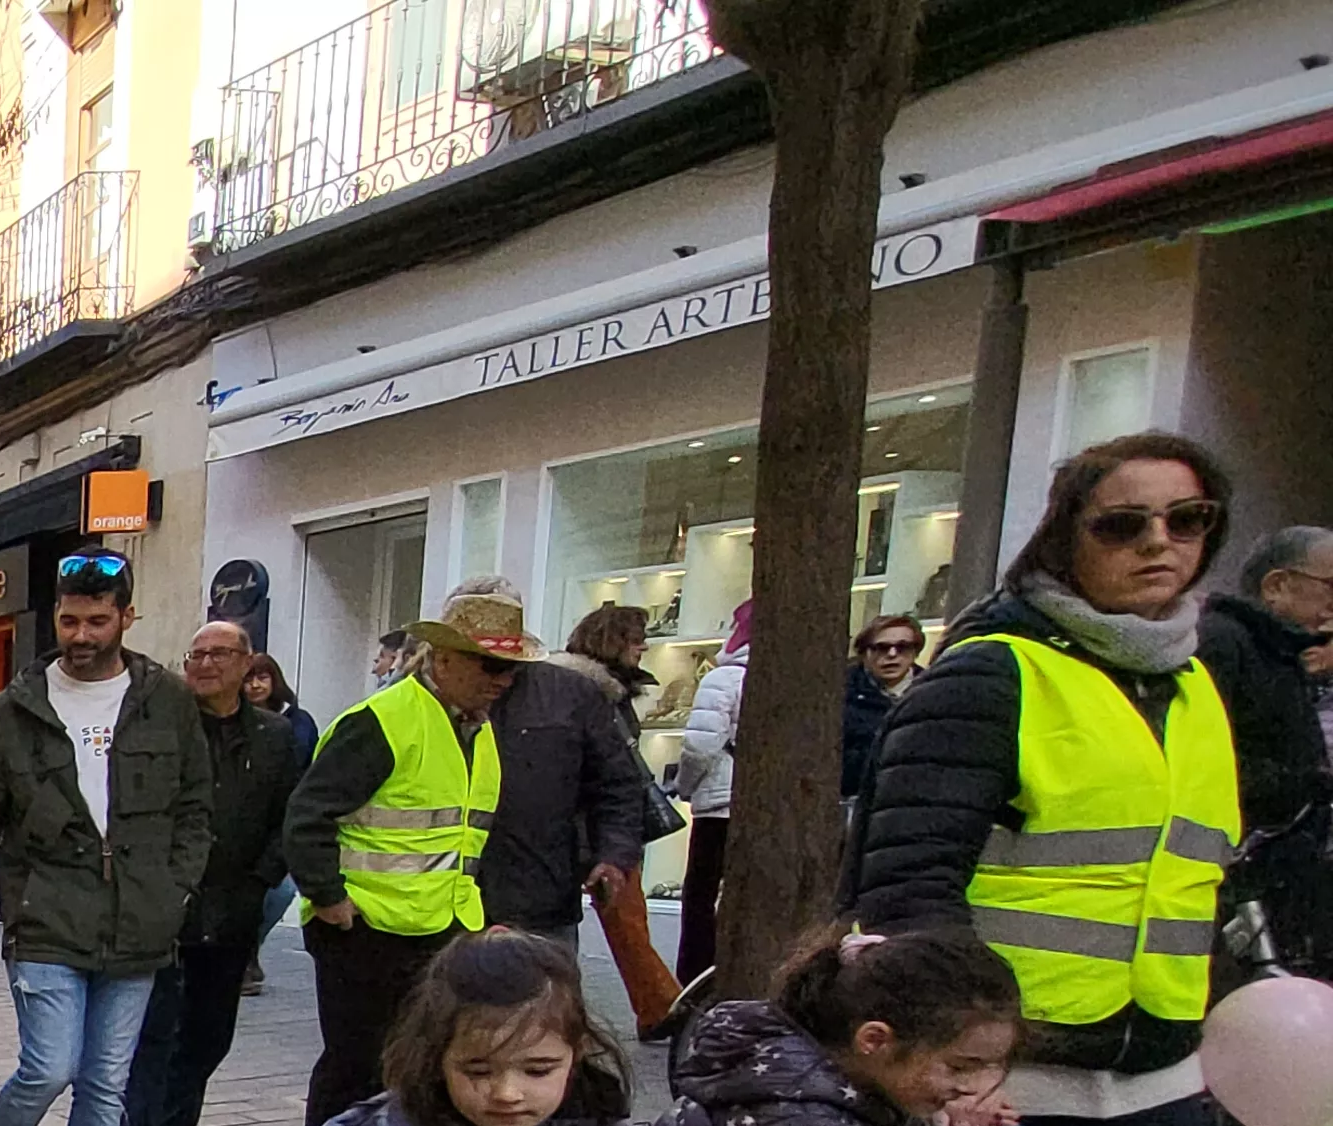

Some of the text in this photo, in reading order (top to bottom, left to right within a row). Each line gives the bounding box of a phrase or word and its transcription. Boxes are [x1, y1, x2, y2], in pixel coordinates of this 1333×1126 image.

[473, 232, 944, 388] TALLER ARTEO
[93, 515, 143, 530] orange
